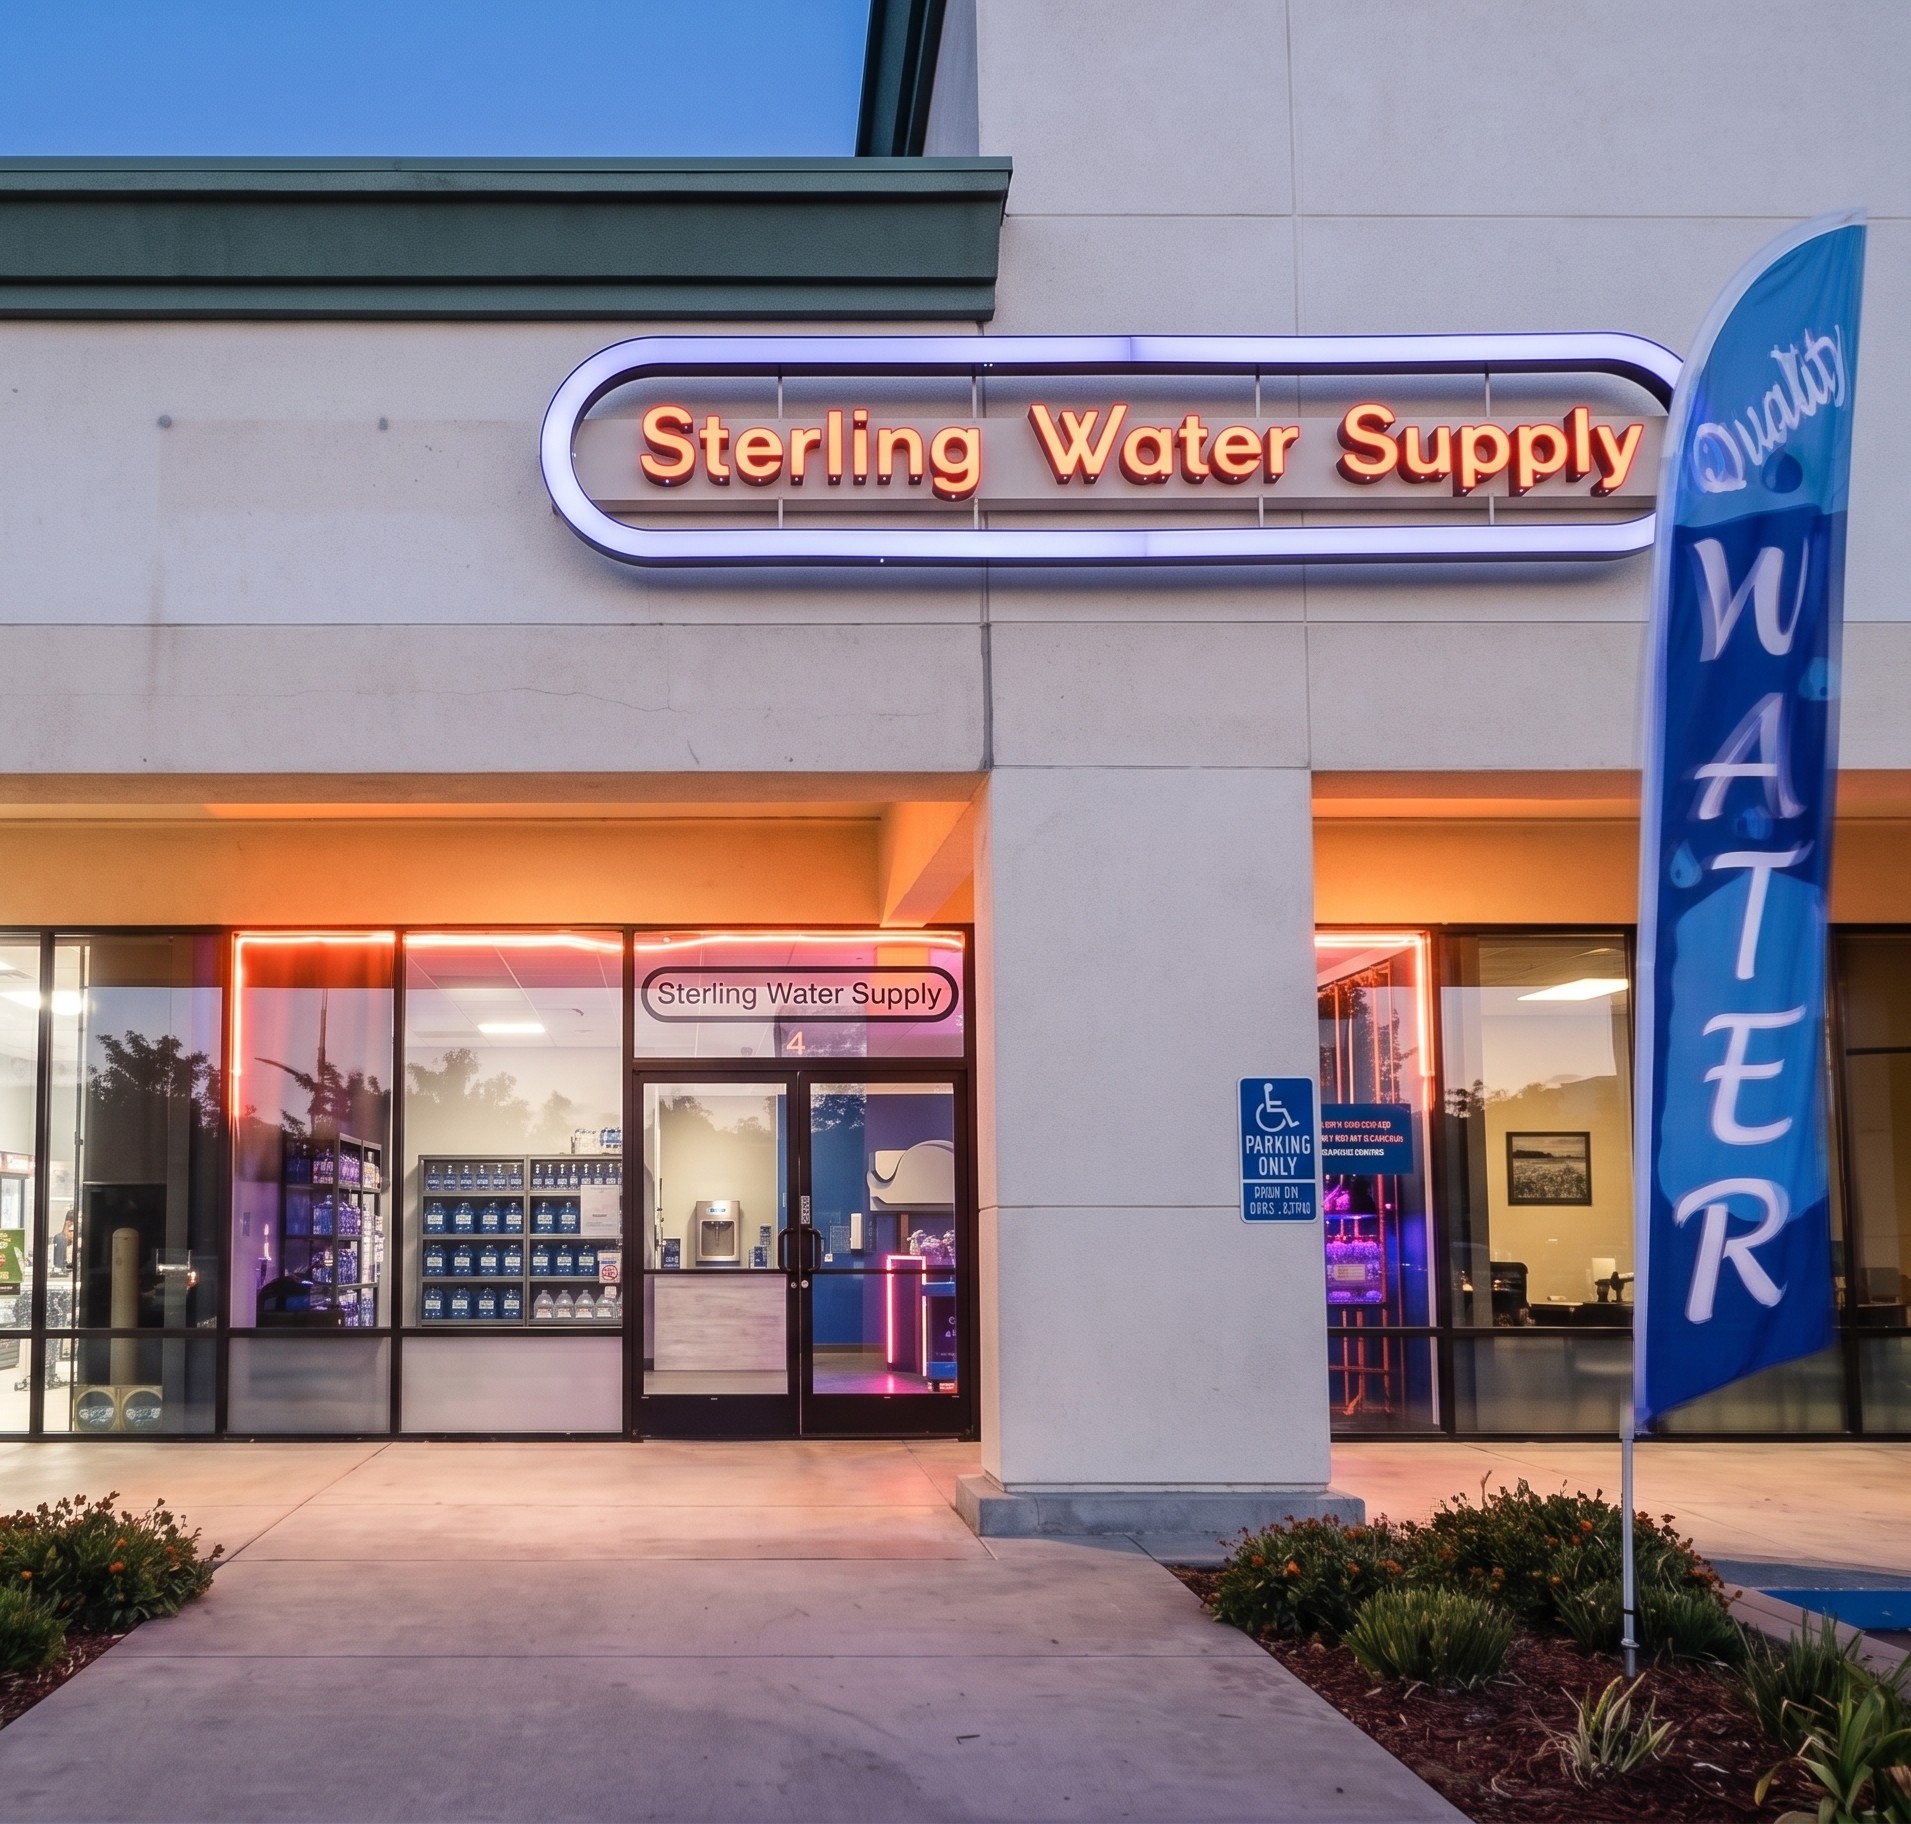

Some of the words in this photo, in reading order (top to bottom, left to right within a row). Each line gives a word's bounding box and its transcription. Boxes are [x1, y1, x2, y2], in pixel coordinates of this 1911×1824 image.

[1692, 325, 1846, 493] Quality
[638, 404, 981, 501] Sterling
[1027, 402, 1300, 485] Water
[1335, 402, 1645, 497] Supply
[1673, 537, 1815, 1325] WATER
[657, 982, 758, 1011] Sterling
[766, 982, 845, 1005] Water
[851, 982, 943, 1011] Supply
[785, 1031, 806, 1056] 4
[1245, 1134, 1311, 1155] PARKING
[1258, 1156, 1298, 1176] ONLY
